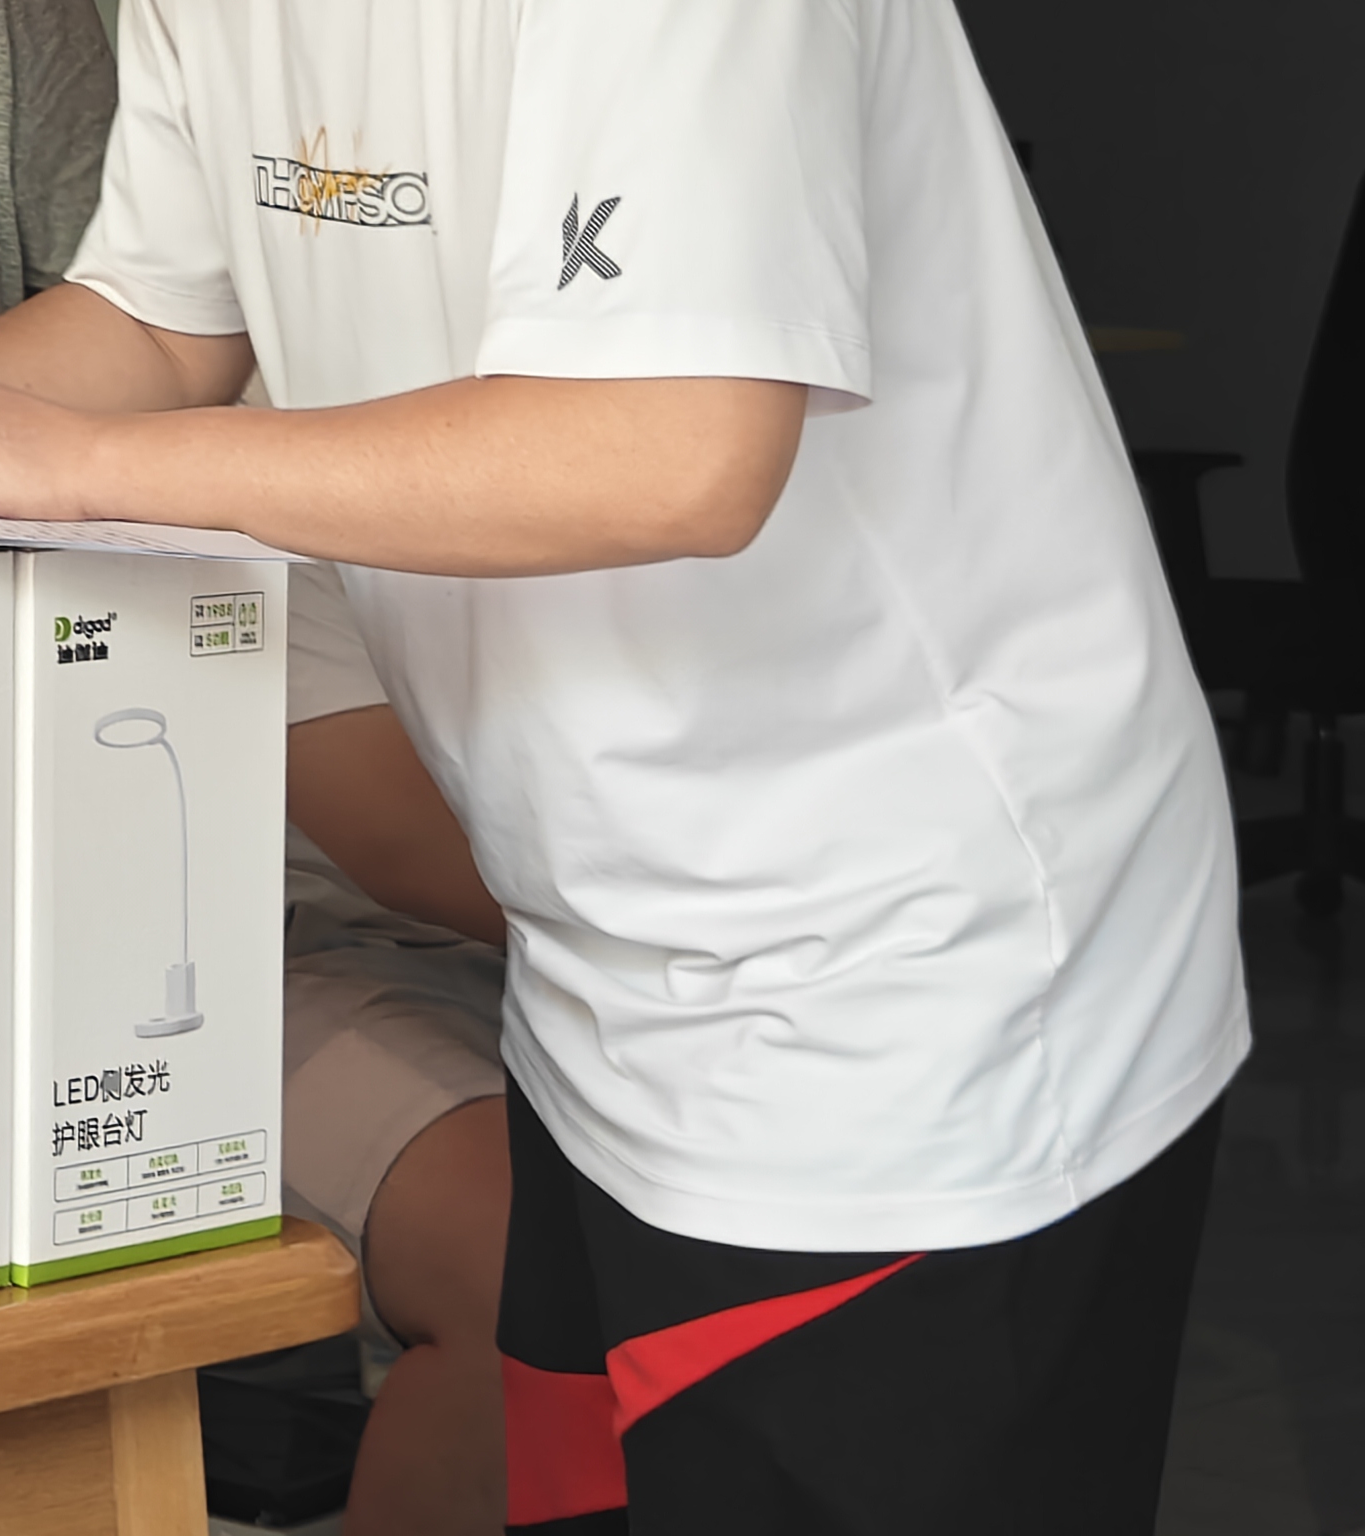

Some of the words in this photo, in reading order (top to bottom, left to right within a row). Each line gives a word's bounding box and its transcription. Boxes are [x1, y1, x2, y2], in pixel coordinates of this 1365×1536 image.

[52, 1059, 171, 1108] LED侧发光
[52, 1109, 148, 1157] 护眼台灯
